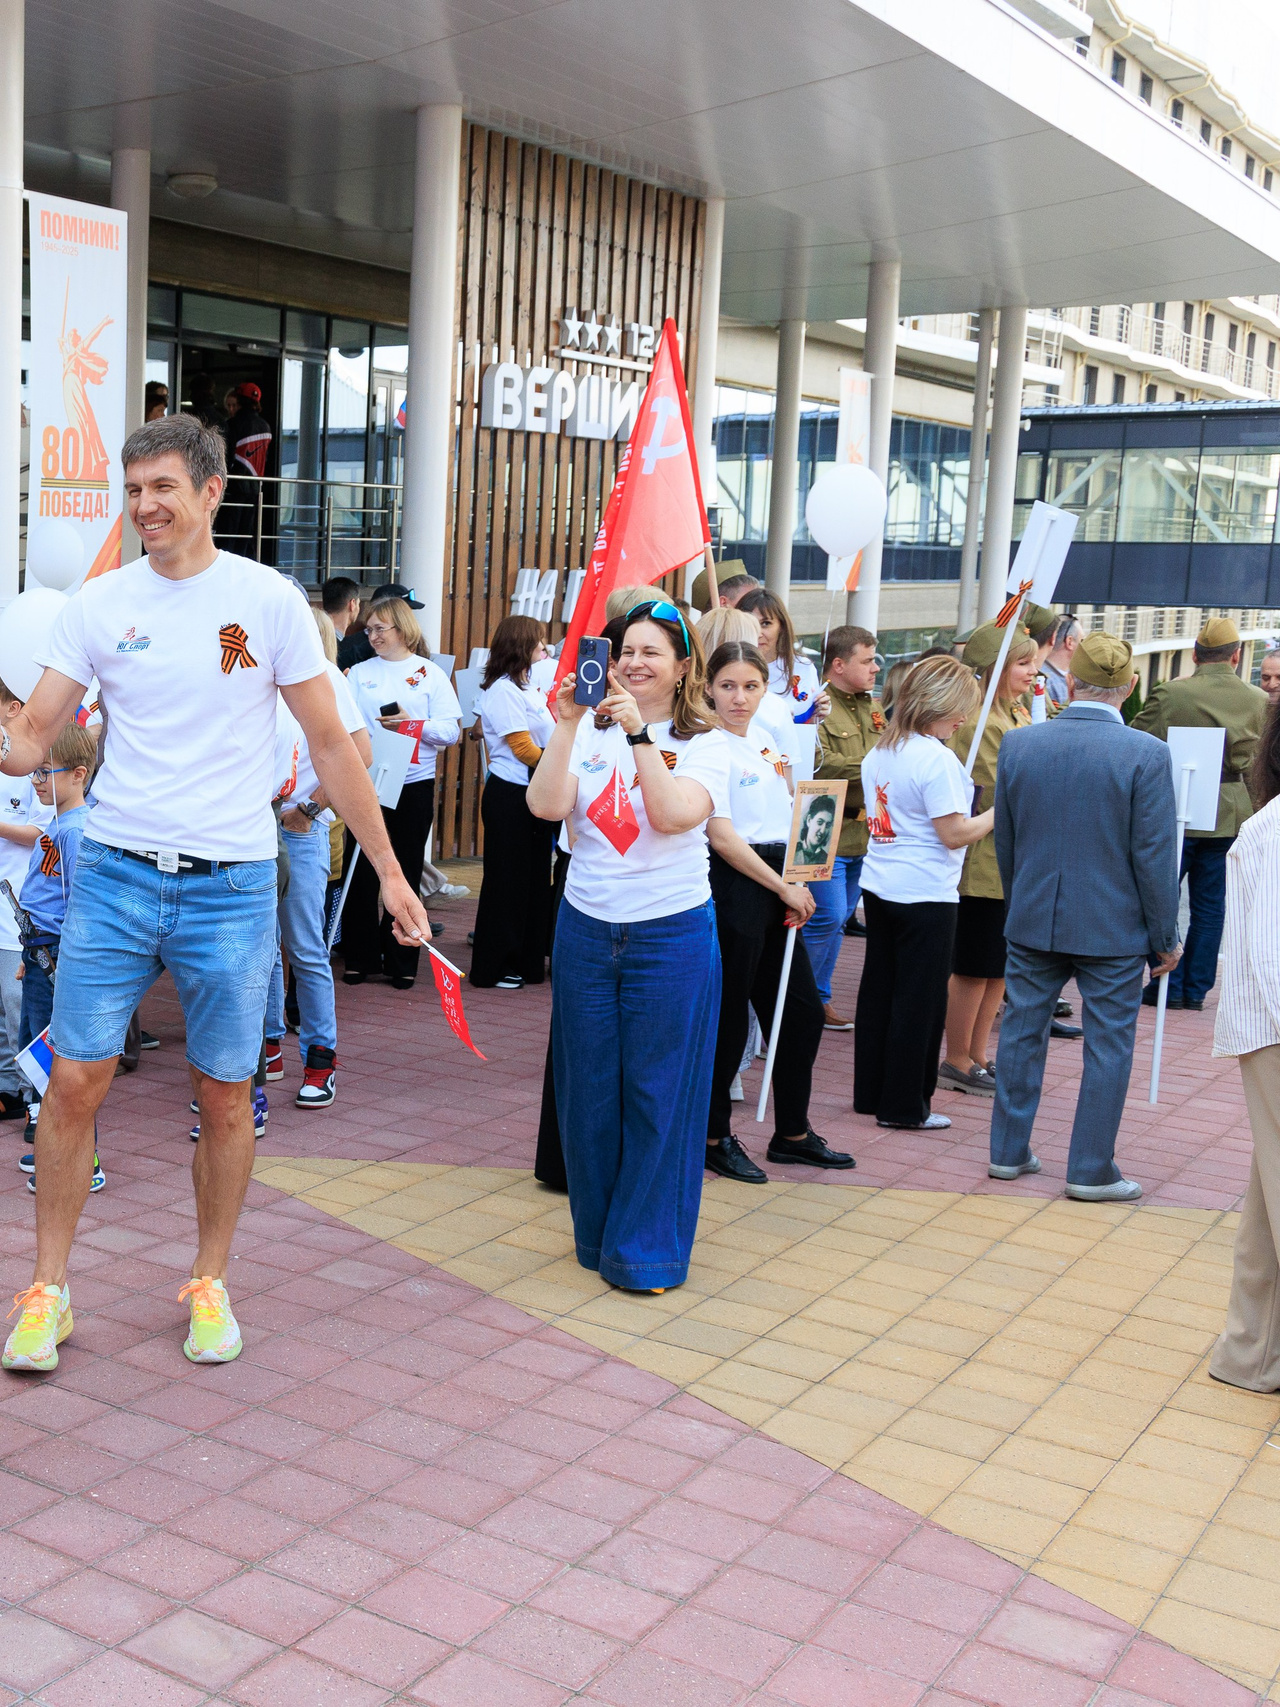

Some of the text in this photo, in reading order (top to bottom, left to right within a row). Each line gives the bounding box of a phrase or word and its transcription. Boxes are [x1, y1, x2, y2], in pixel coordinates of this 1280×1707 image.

[40, 209, 120, 252] ПОМНИМ!
[488, 361, 648, 440] ВЕРШИ
[41, 425, 80, 480] 80
[39, 490, 109, 522] ПОБЕДА!
